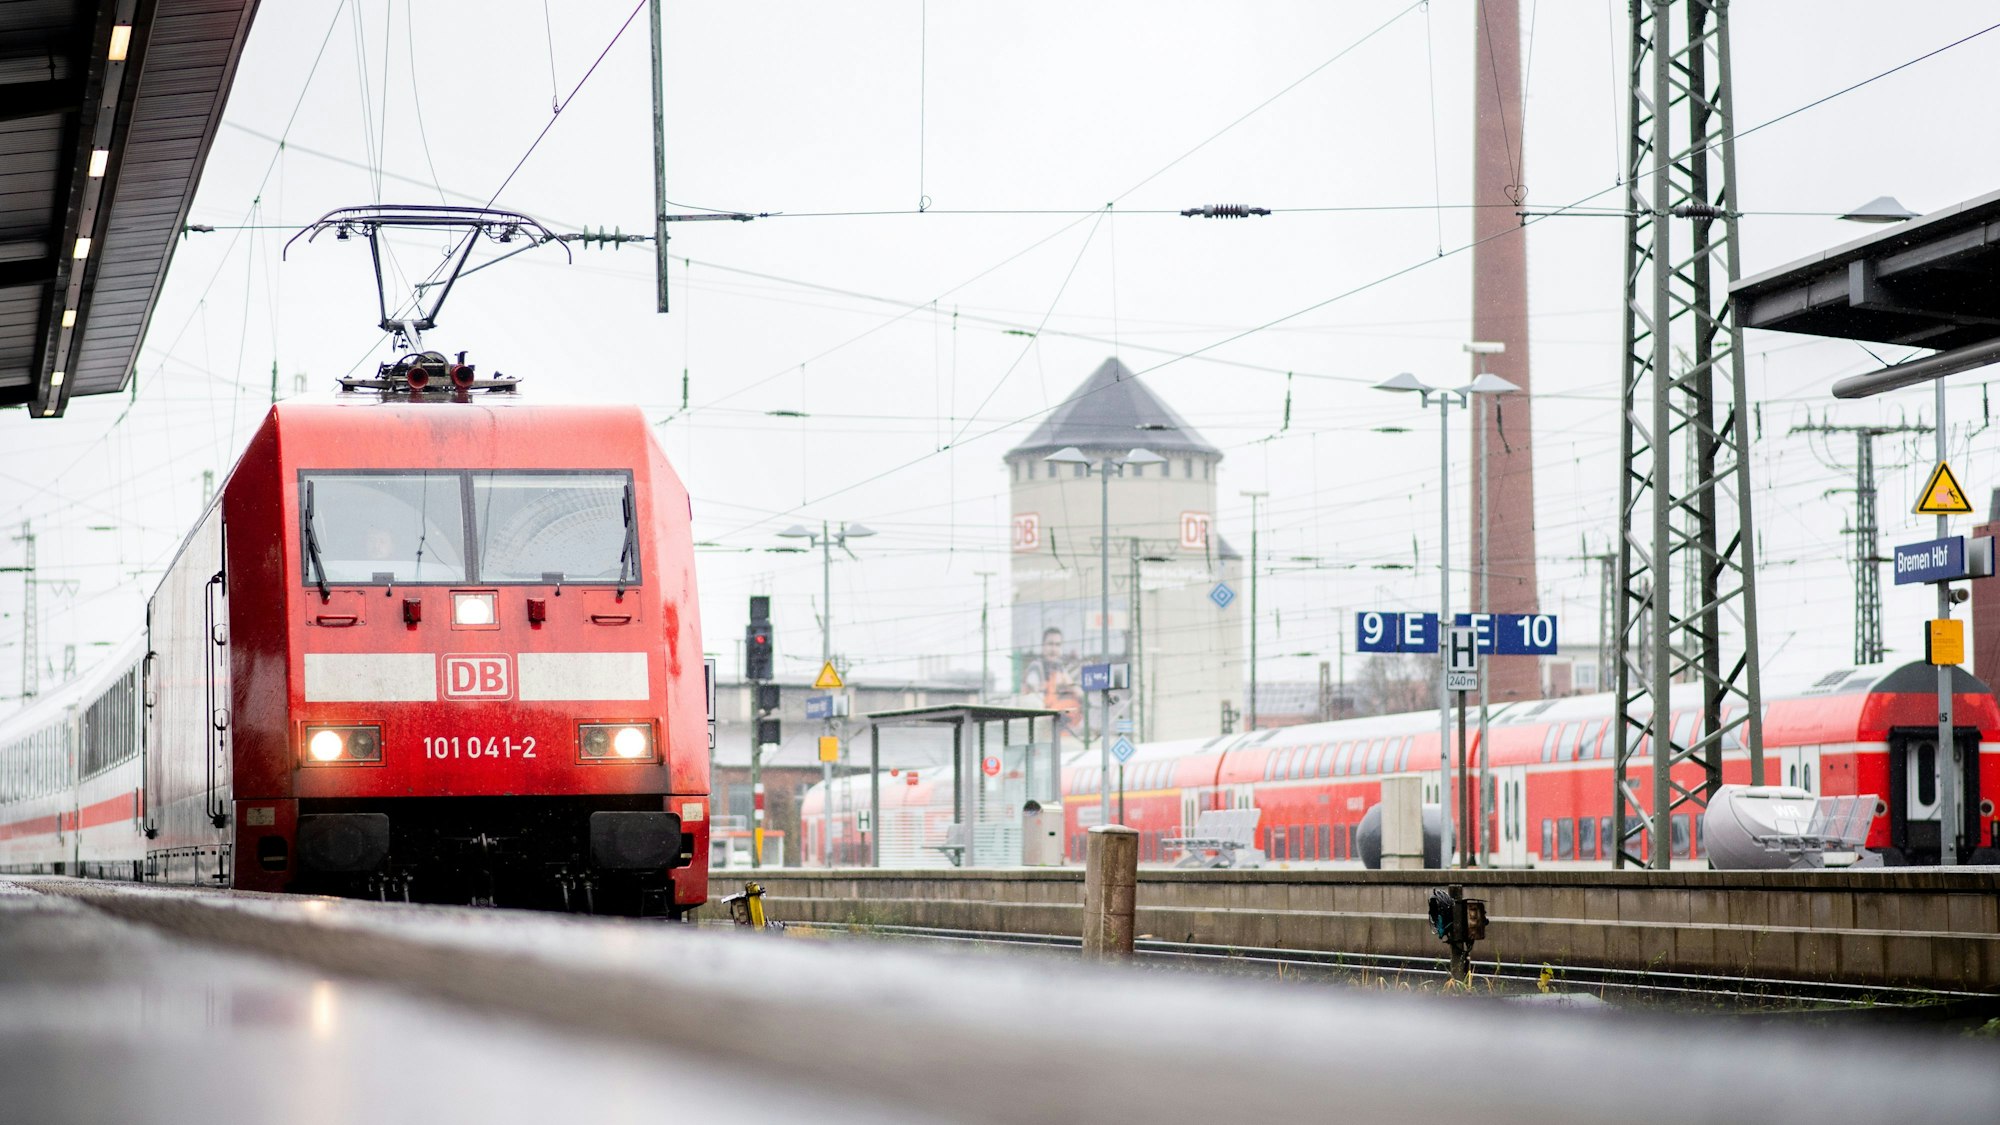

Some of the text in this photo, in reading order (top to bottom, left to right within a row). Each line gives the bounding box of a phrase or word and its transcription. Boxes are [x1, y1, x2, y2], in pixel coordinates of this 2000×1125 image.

[1897, 544, 1948, 573] Bremen Hbf
[1362, 612, 1425, 645] 9 E
[1470, 614, 1553, 648] E 10
[1451, 631, 1474, 668] H
[451, 661, 504, 692] DB
[423, 736, 537, 759] 101 041-2
[857, 810, 871, 830] H
[1772, 805, 1801, 818] WR
